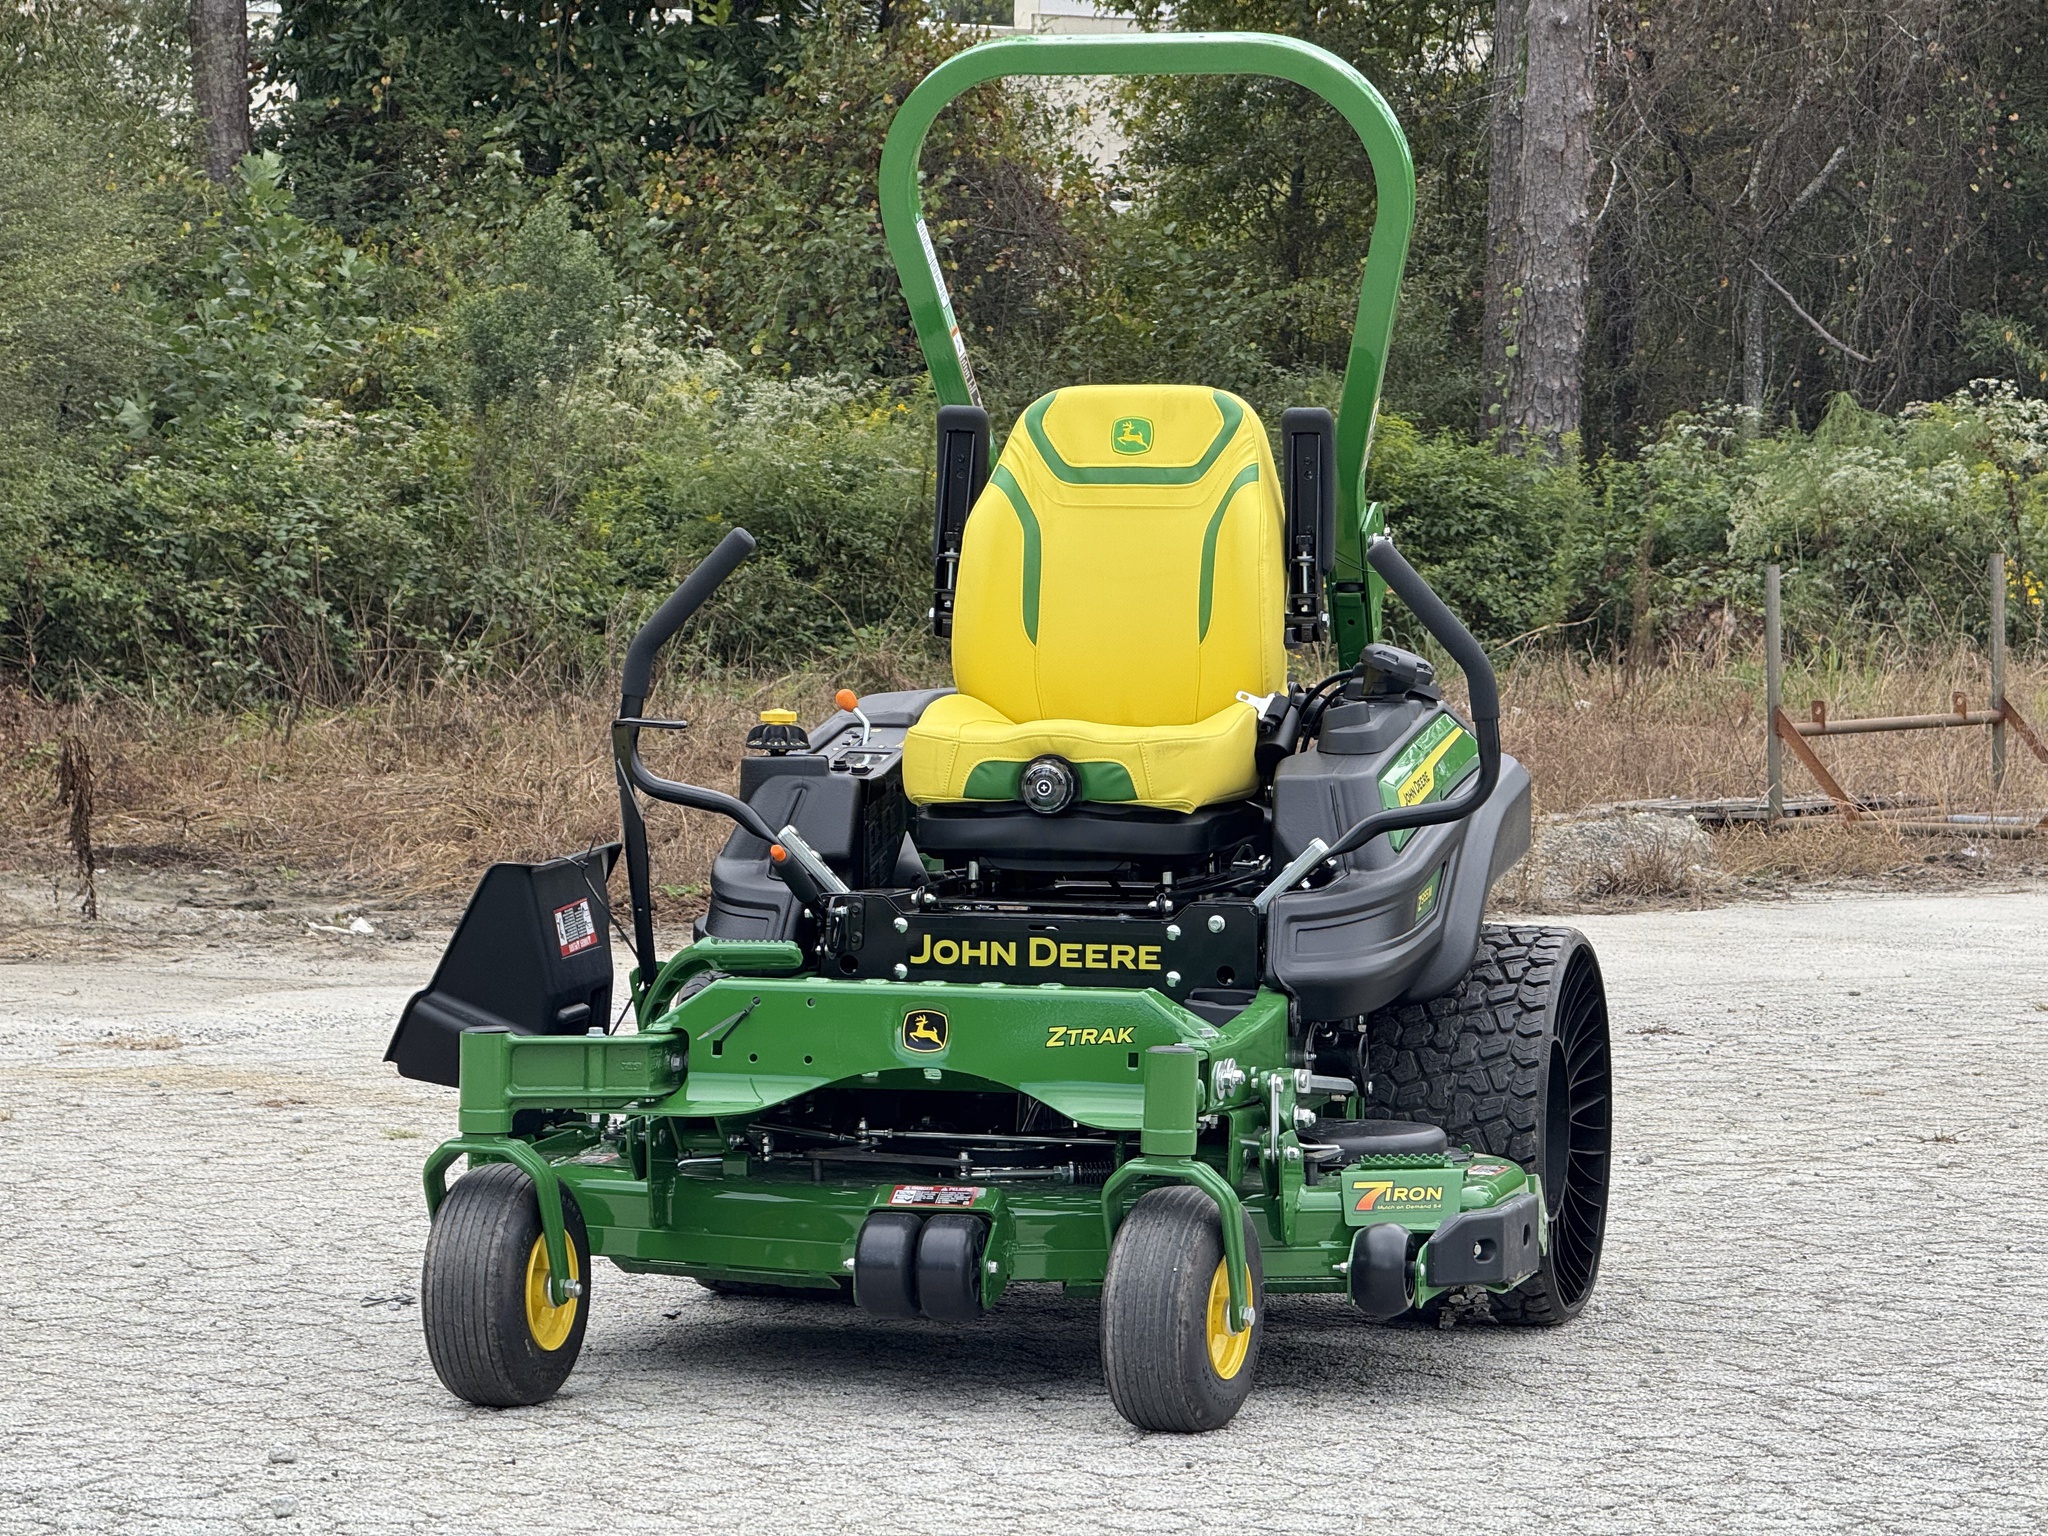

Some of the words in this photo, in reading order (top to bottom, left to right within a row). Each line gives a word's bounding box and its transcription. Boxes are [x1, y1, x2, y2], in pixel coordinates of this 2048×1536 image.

[1413, 771, 1430, 793] DEERE
[910, 934, 1016, 966] JOHN
[1029, 937, 1161, 970] DEERE
[1045, 1026, 1136, 1047] ZTRAK
